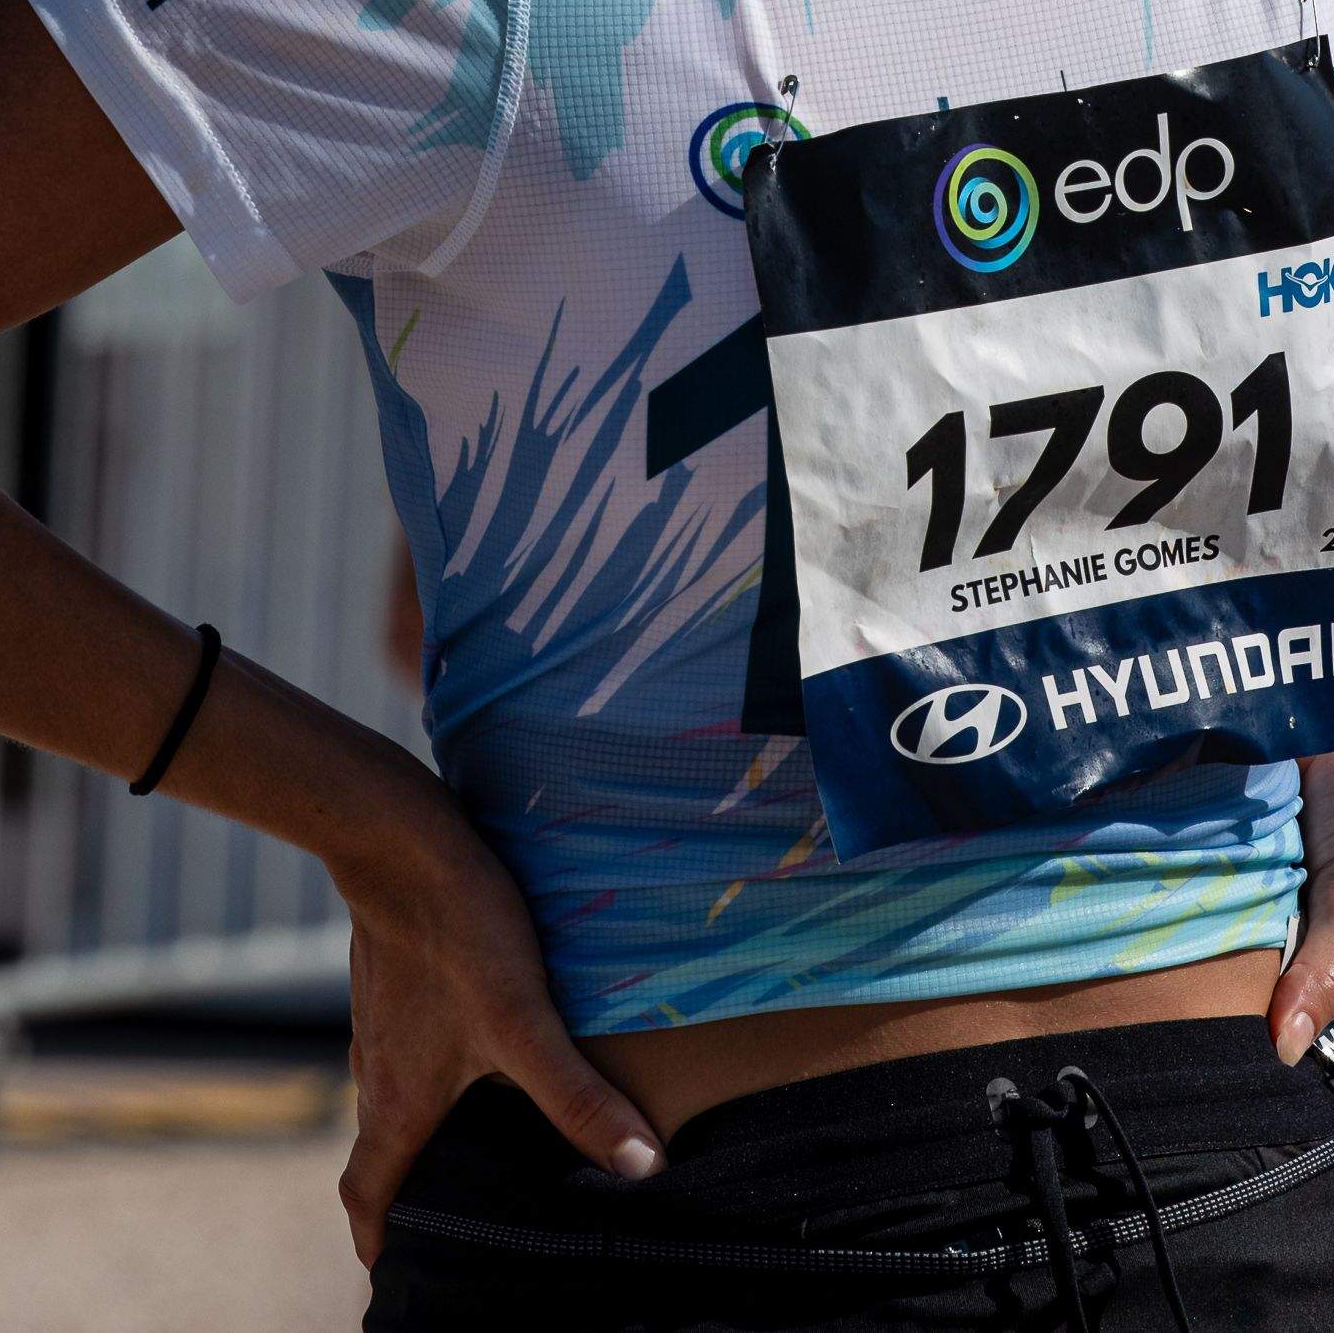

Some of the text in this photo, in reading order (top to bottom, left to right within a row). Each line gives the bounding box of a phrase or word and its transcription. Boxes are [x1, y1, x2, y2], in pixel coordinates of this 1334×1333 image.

[1054, 112, 1235, 232] edp
[905, 350, 1293, 574] 1791
[950, 534, 1221, 614] STEPHANIE GOMES
